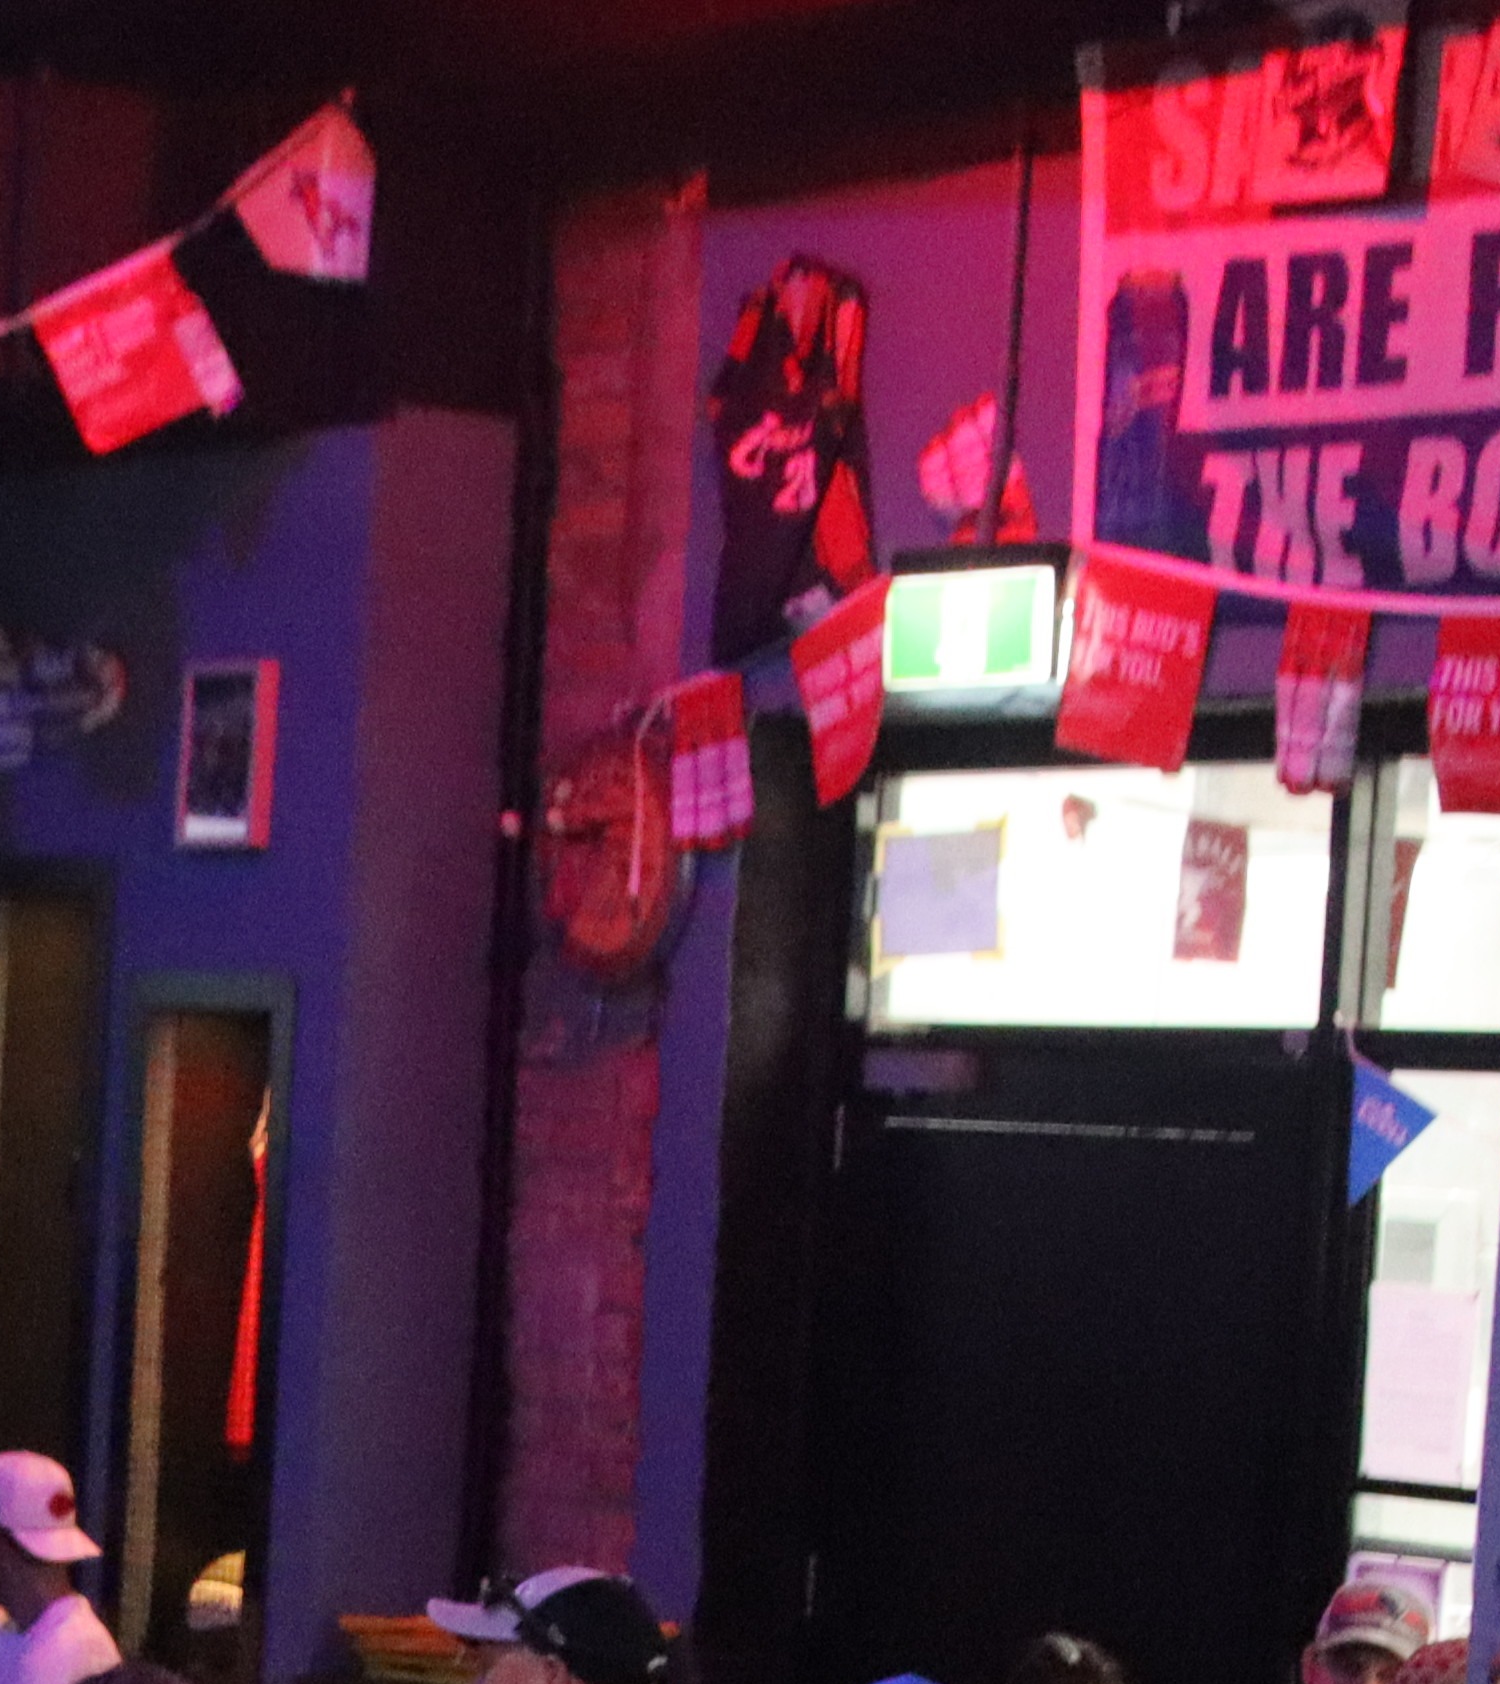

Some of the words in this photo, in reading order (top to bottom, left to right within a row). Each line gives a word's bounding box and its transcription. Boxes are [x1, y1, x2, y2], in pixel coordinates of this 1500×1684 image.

[1212, 240, 1412, 396] ARE
[1202, 440, 1363, 588] THE
[1431, 697, 1481, 735] FOR
[1434, 655, 1498, 692] THIS
